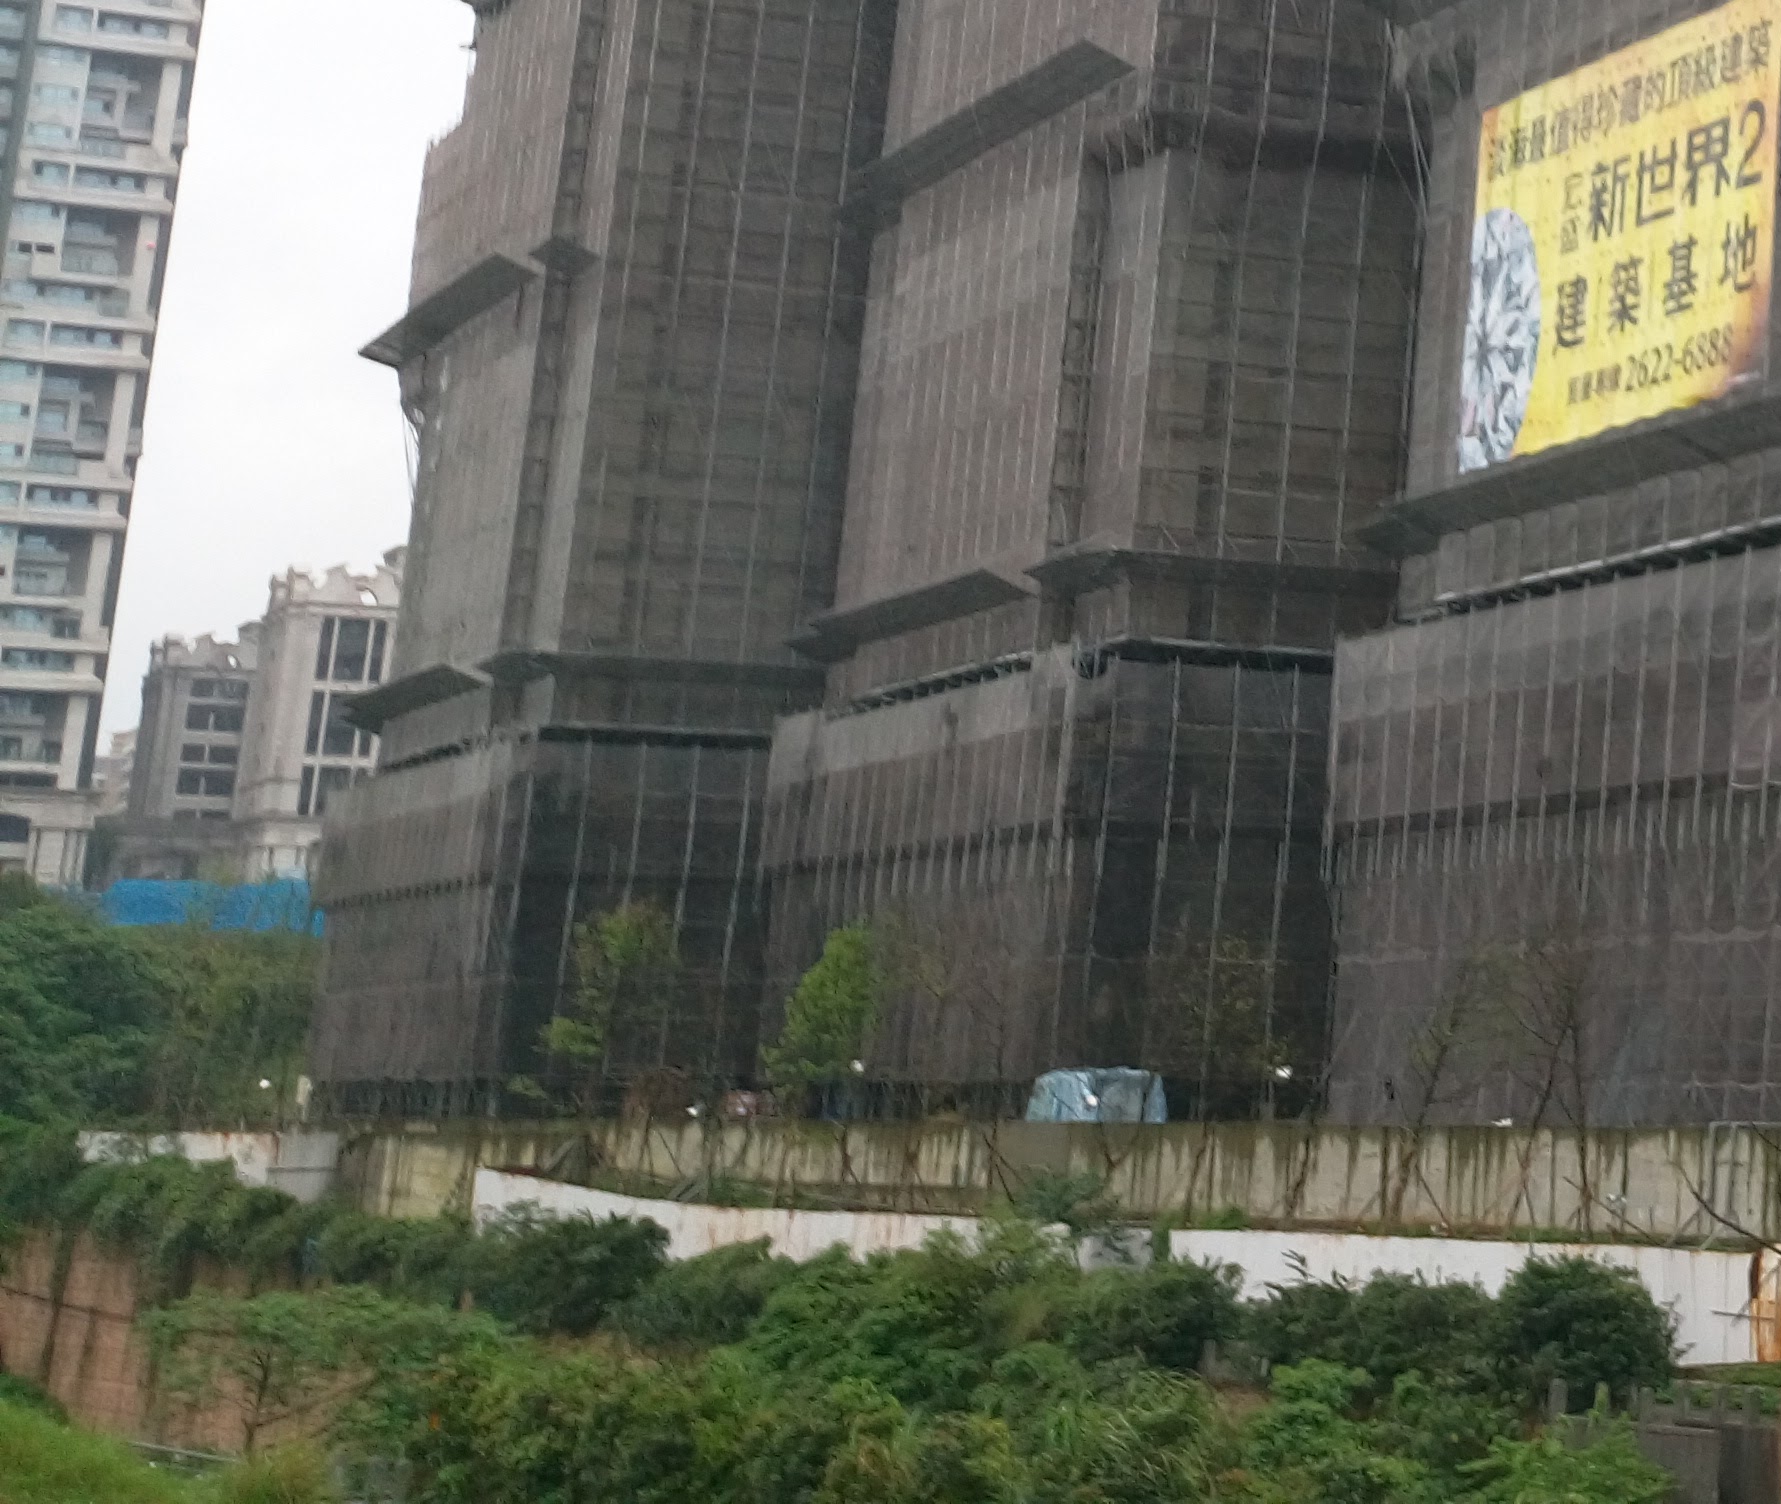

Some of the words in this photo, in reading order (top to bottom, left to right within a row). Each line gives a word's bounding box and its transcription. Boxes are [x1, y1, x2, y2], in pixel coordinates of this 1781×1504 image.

[1585, 100, 1767, 243] 新世界2
[1553, 213, 1758, 353] 建築基地
